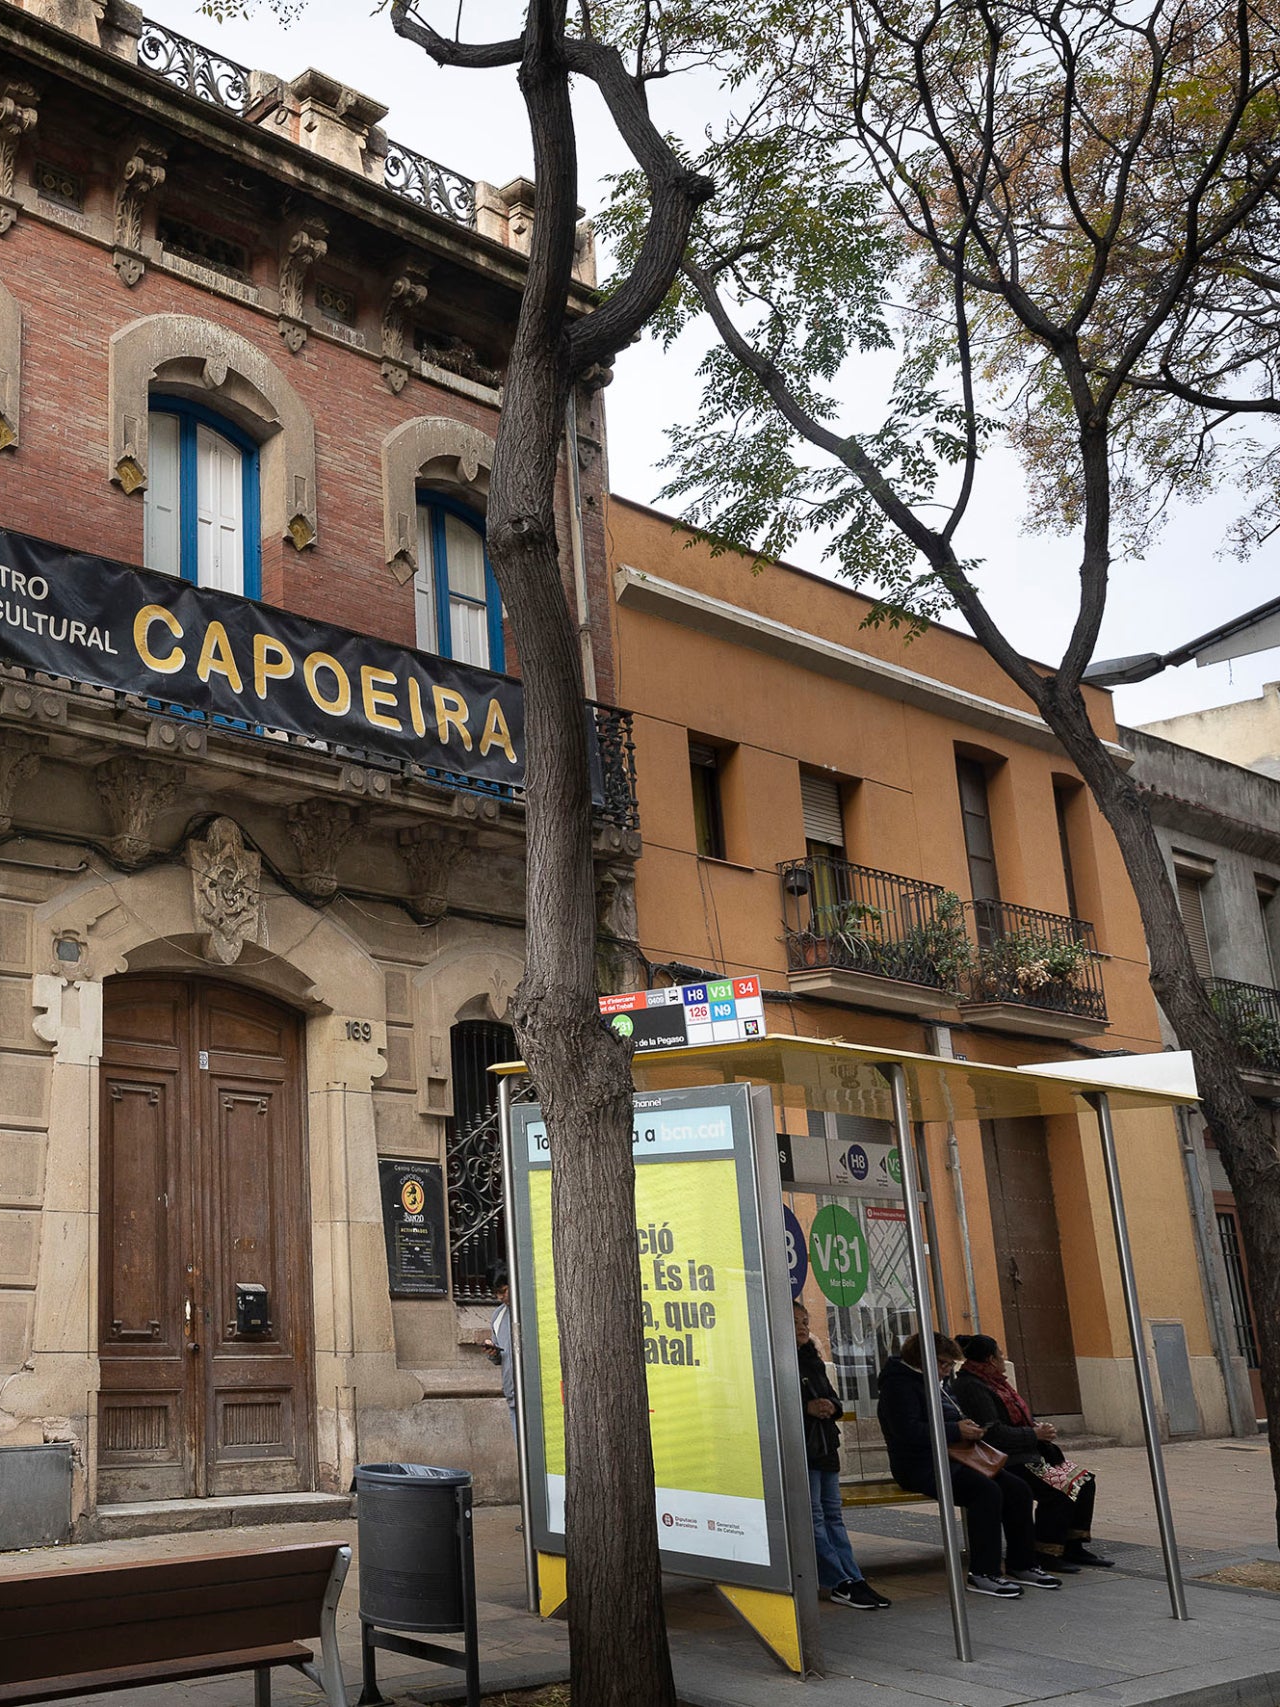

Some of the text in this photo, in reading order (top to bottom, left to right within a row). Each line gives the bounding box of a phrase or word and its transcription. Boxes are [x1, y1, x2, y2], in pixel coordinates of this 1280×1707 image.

[133, 604, 518, 764] CAPOEIRA
[687, 989, 704, 1001] H8
[711, 983, 732, 998] V31
[738, 983, 754, 995] 34
[688, 1006, 708, 1018] 126
[714, 1004, 731, 1016] N9
[345, 1021, 372, 1041] 169
[638, 1038, 648, 1047] de
[649, 1036, 656, 1046] la
[657, 1035, 685, 1046] Pegaso
[534, 1134, 550, 1150] To
[645, 1128, 656, 1143] a
[661, 1119, 726, 1140] bcn.cat
[850, 1154, 865, 1169] H8
[888, 1158, 901, 1172] V3
[637, 1222, 674, 1254] ció
[785, 1230, 798, 1269] 8
[812, 1233, 863, 1273] V31
[653, 1254, 716, 1291] És la
[642, 1301, 716, 1331] a, que
[644, 1334, 701, 1366] atal.
